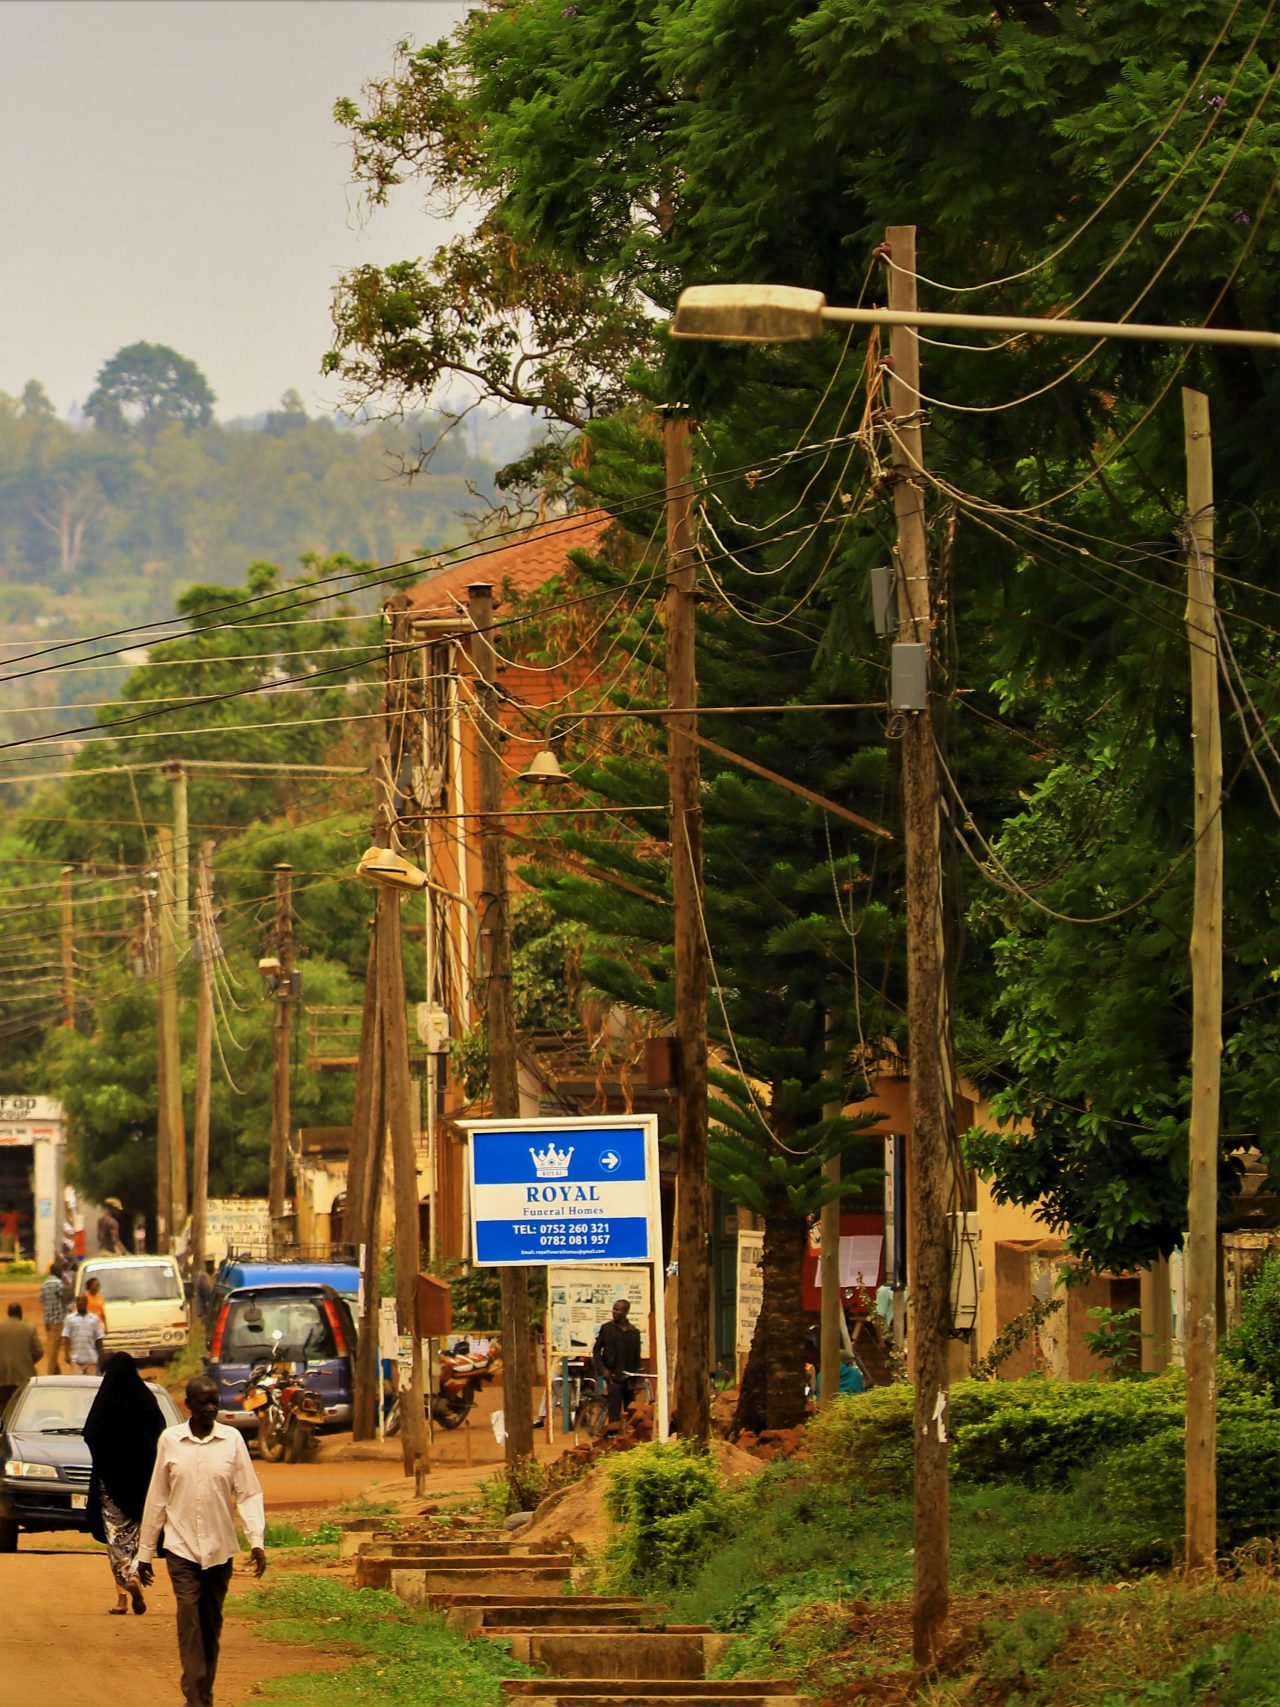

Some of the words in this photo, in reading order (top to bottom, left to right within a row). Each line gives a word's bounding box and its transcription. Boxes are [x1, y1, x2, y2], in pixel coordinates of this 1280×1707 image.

[526, 1185, 600, 1202] ROYAL
[523, 1206, 565, 1216] Funeral
[568, 1206, 604, 1215] Homes
[512, 1225, 537, 1235] TEL:
[540, 1224, 566, 1234] 0752
[568, 1223, 588, 1233] 260
[590, 1223, 610, 1233] 321
[540, 1235, 567, 1245] 0782
[568, 1235, 588, 1245] 081
[591, 1235, 611, 1245] 957
